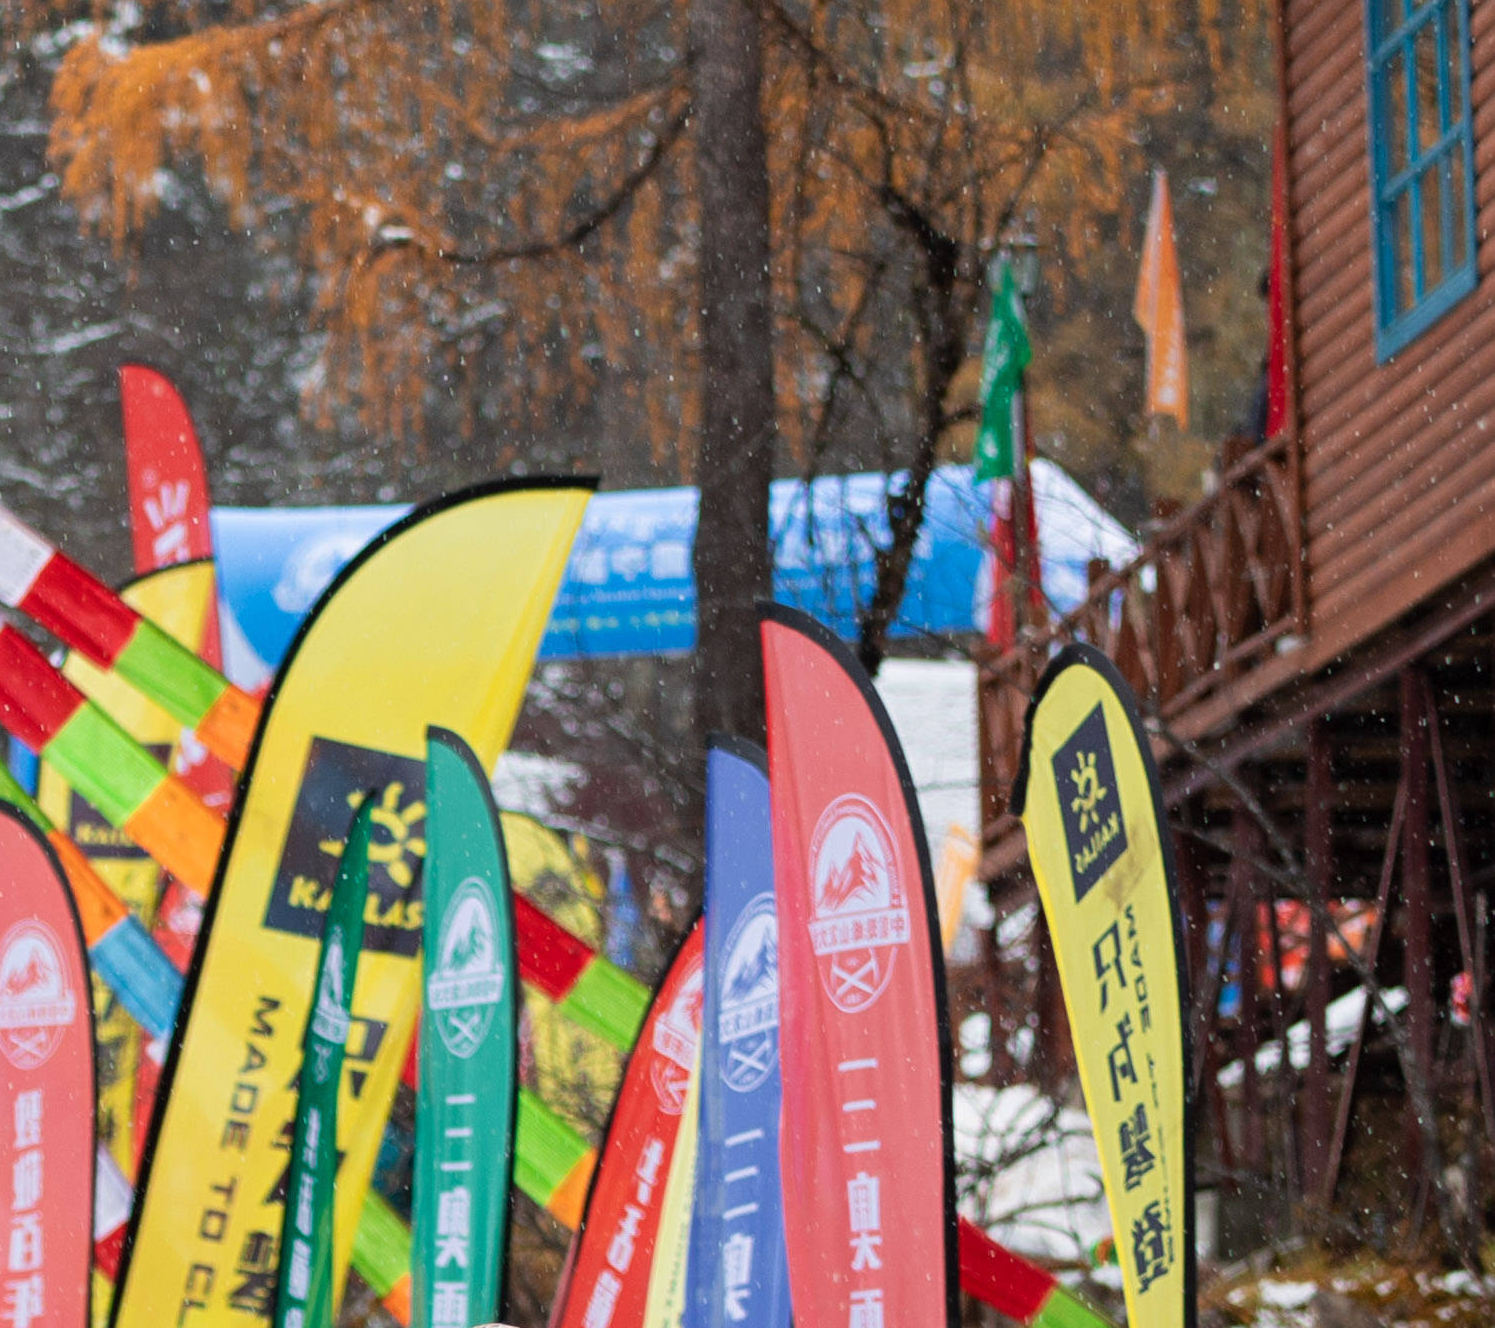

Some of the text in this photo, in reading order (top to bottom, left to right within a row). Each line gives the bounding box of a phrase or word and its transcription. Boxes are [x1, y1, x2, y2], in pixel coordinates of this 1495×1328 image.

[287, 874, 424, 931] KALAS
[218, 992, 282, 1152] MADE
[198, 1173, 239, 1244] TO
